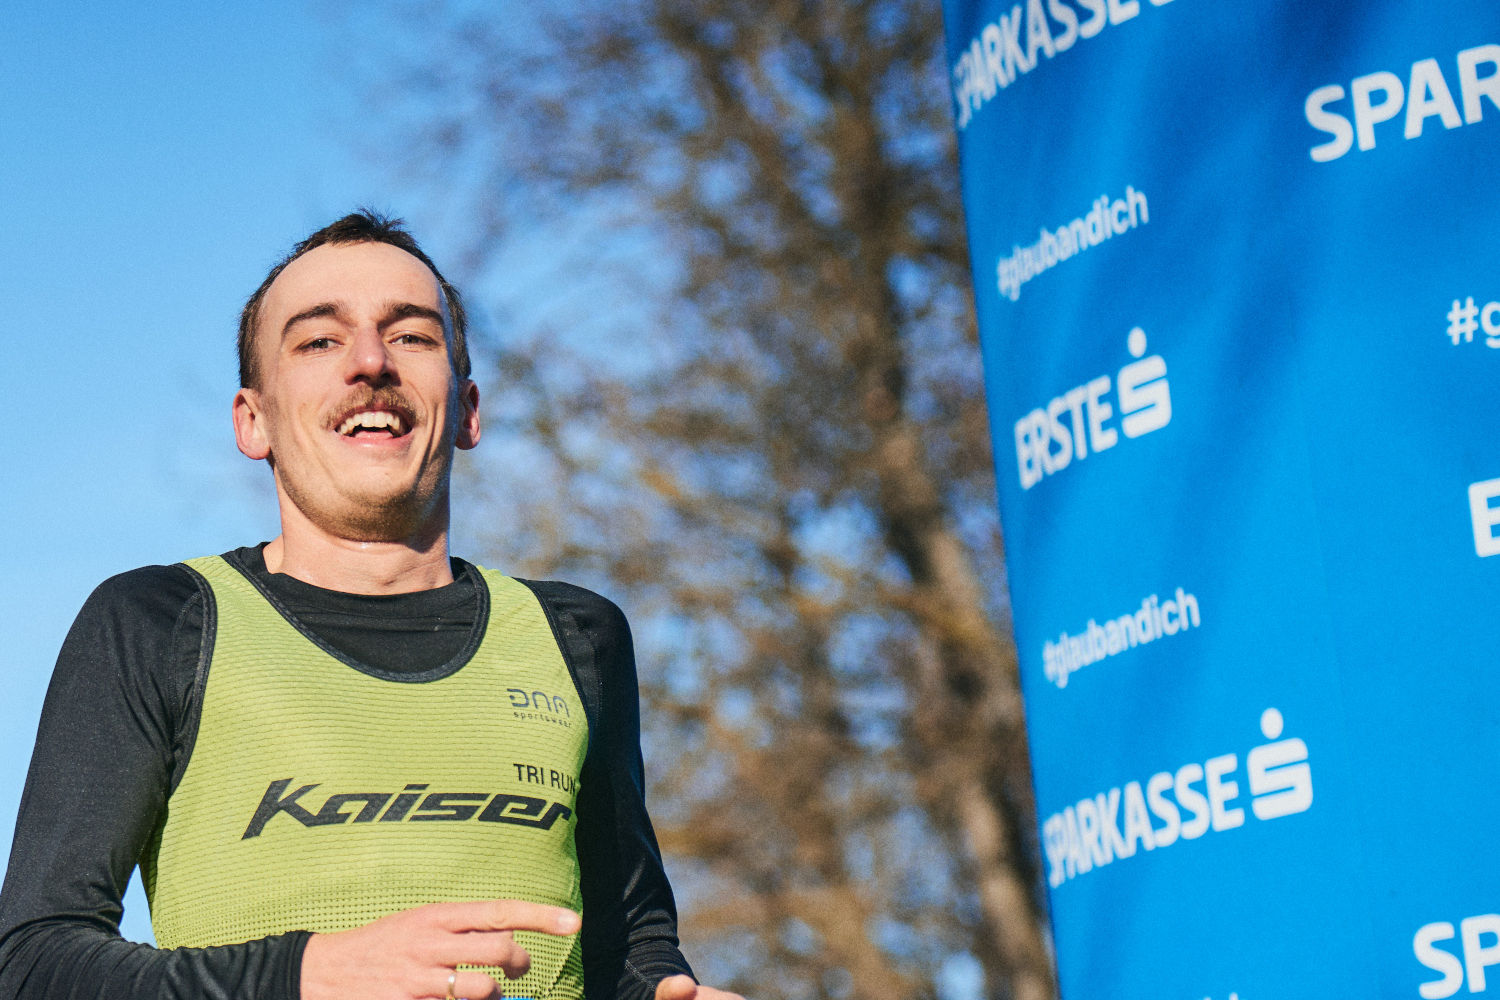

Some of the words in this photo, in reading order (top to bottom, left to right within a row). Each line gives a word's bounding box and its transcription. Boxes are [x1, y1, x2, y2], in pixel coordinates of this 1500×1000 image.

[997, 186, 1149, 300] #glaubandich
[1015, 376, 1117, 489] ERSTE
[1043, 588, 1201, 688] #glaubandich
[241, 778, 573, 840] Kaiser
[513, 763, 544, 785] TRI
[1043, 753, 1245, 888] SPARKASSE
